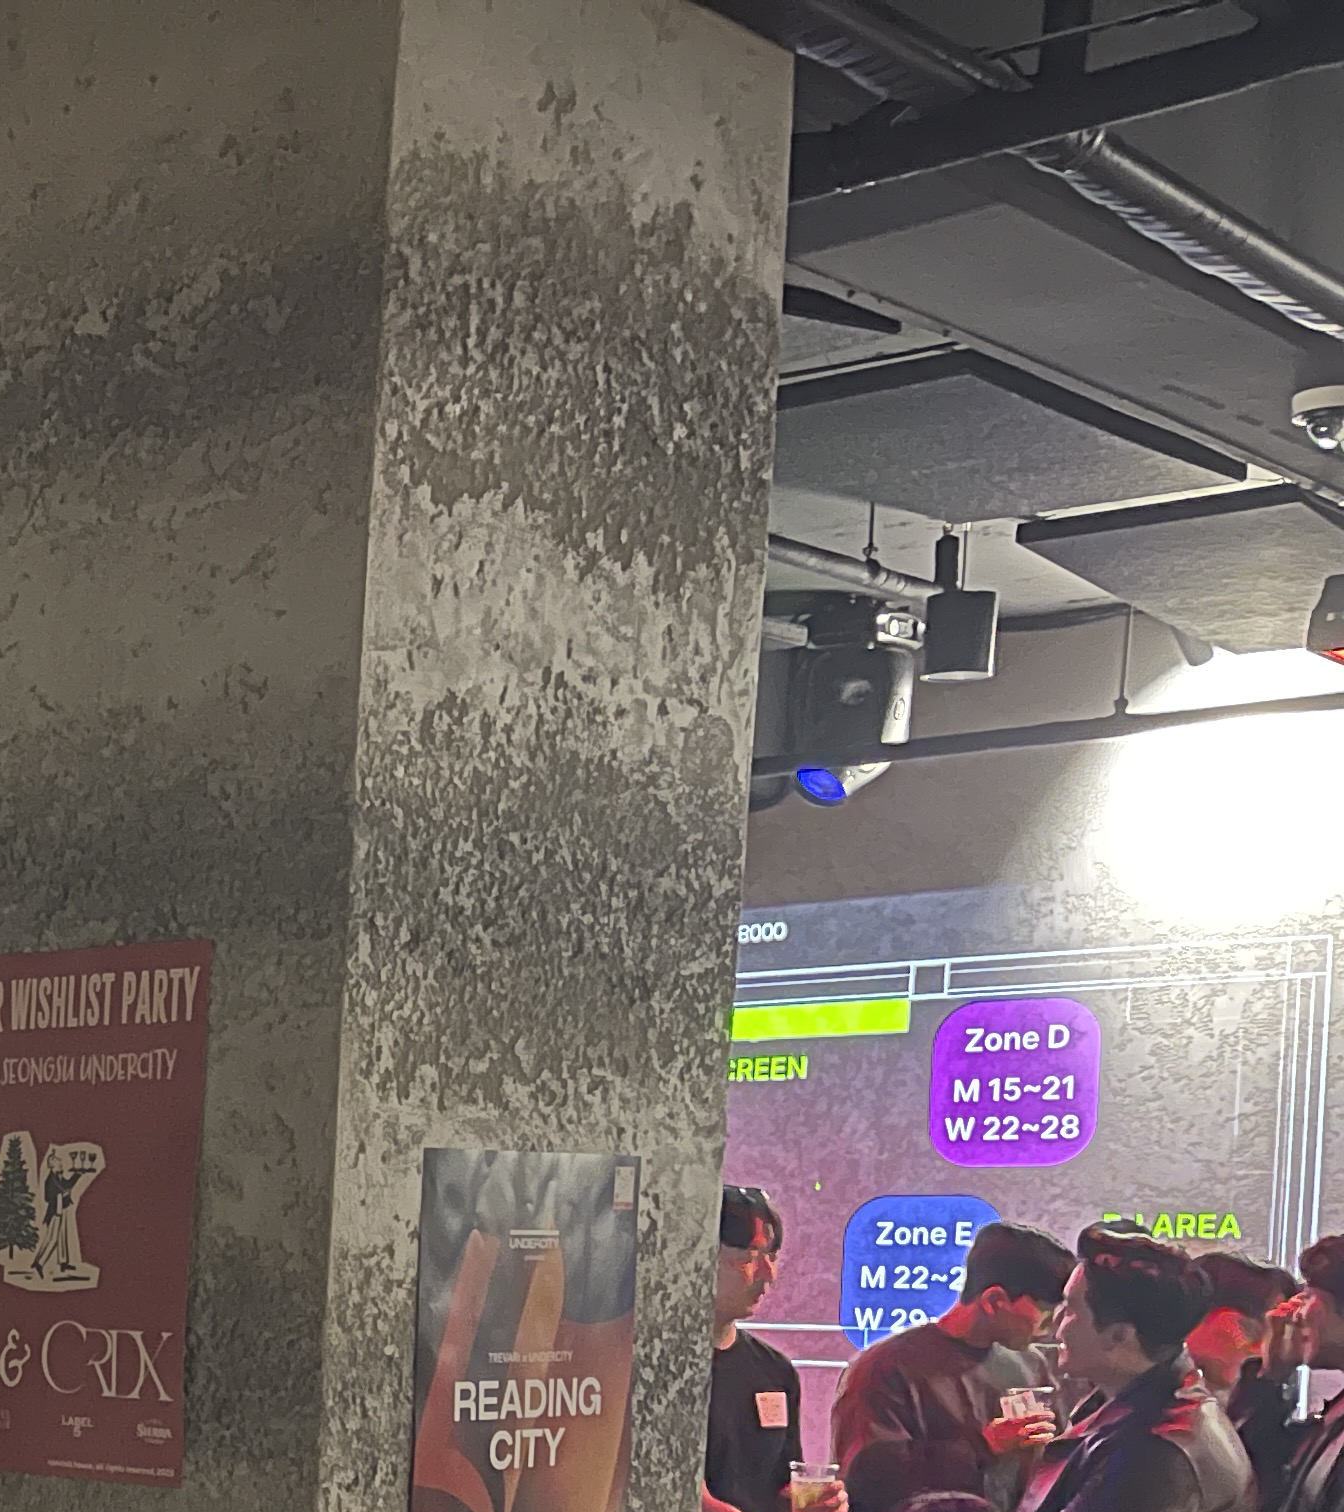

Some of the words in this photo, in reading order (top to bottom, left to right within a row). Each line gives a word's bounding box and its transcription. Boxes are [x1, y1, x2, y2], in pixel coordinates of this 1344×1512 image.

[11, 972, 115, 1030] WISHLIST
[121, 966, 200, 1024] PARTY
[965, 1027, 1040, 1053] Zone
[1047, 1024, 1070, 1049] D
[0, 1053, 74, 1087] SEONGSU
[79, 1048, 178, 1085] UNDERCITY
[953, 1078, 980, 1103] M
[988, 1075, 1074, 1102] 15~21
[944, 1116, 976, 1142] W
[982, 1114, 1080, 1141] 22~28
[875, 1221, 947, 1246] Zone
[954, 1221, 973, 1247] E
[1151, 1212, 1242, 1239] AREA
[860, 1265, 886, 1289] M
[893, 1265, 966, 1290] 22~2
[854, 1307, 884, 1331] W
[0, 1328, 31, 1388] &
[454, 1376, 602, 1422] READING
[489, 1427, 566, 1470] CITY
